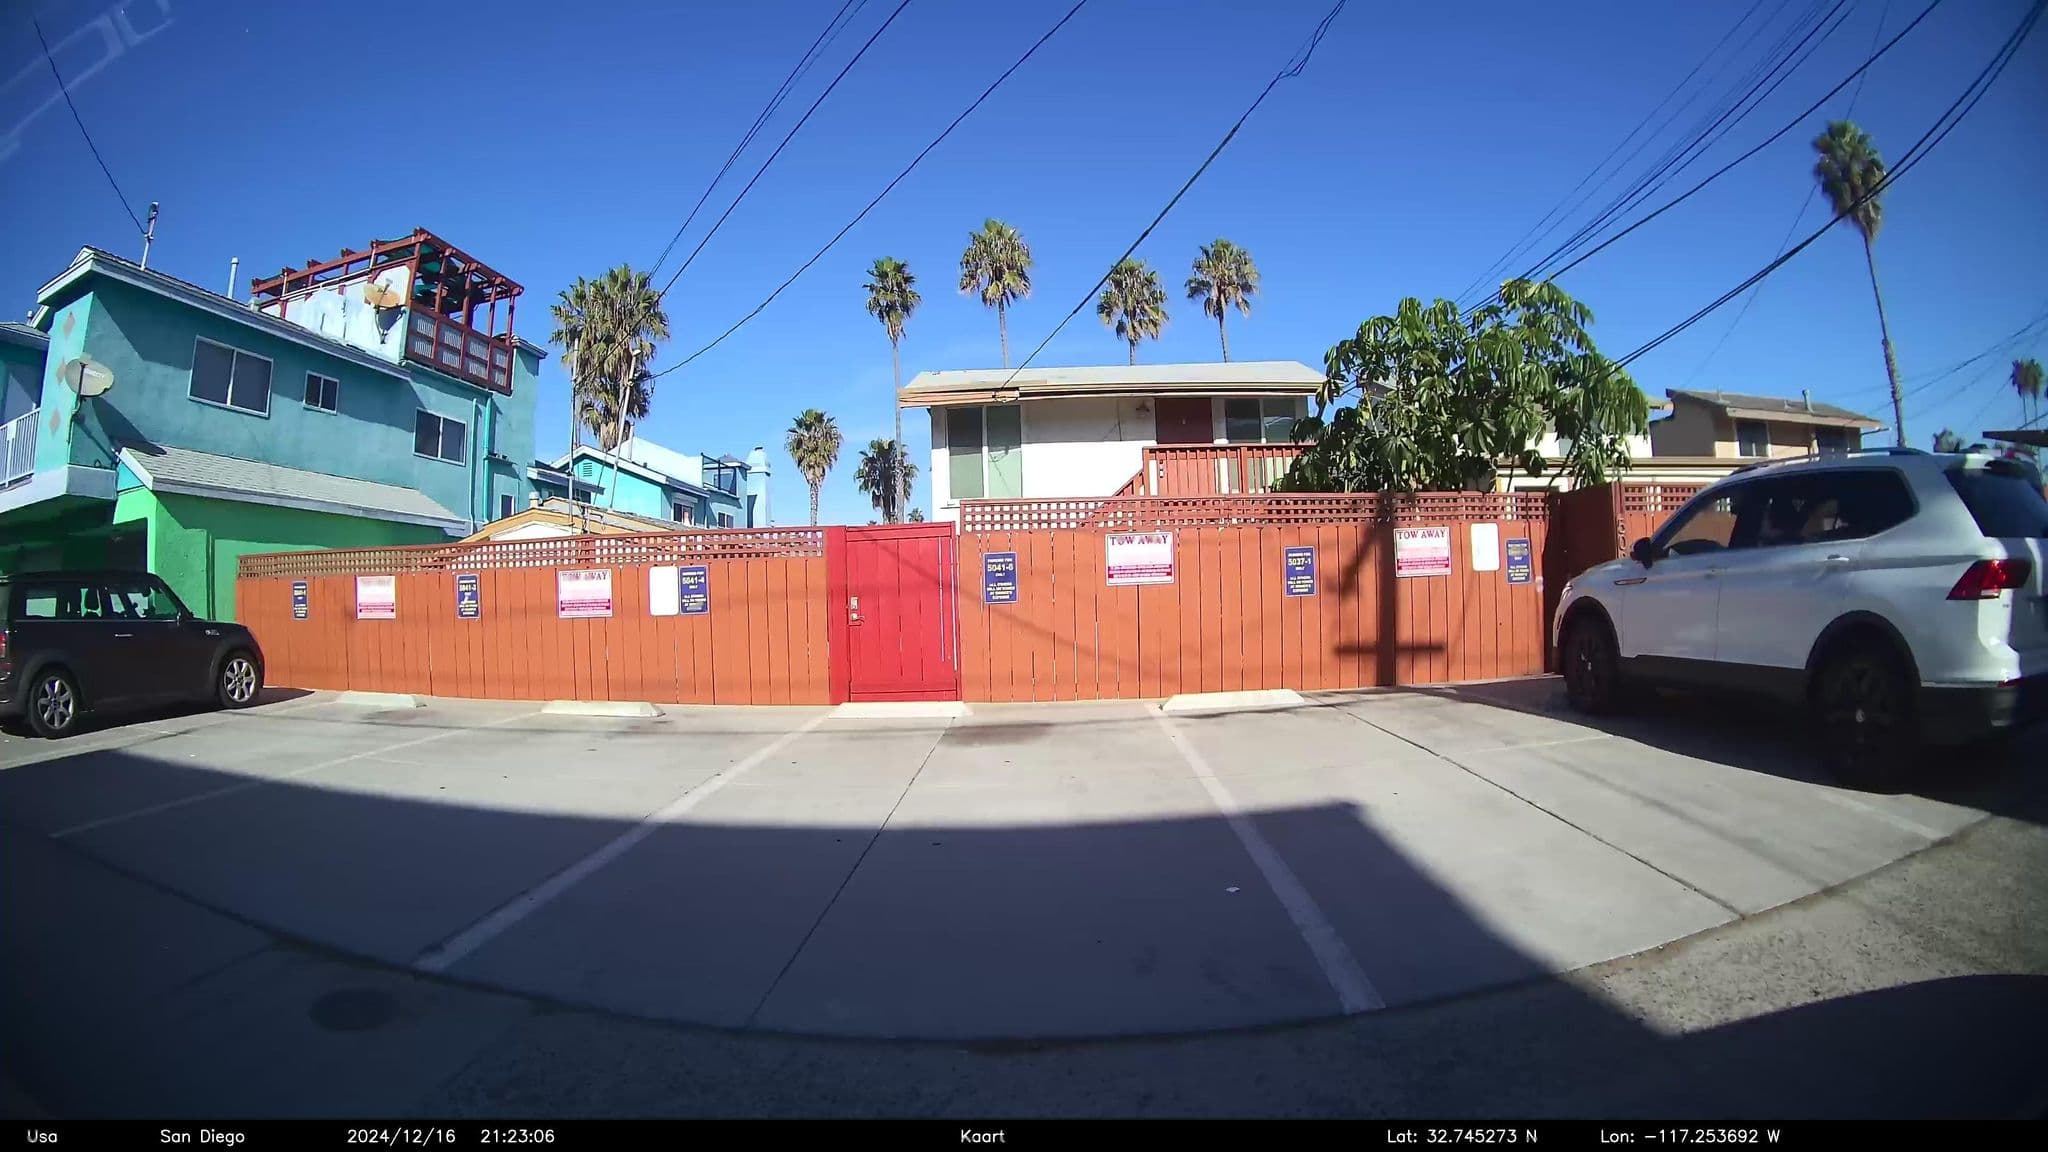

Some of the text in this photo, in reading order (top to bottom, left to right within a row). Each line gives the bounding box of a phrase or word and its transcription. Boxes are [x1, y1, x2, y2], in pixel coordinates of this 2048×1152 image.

[1110, 534, 1168, 546] TOW AWAY
[1397, 529, 1446, 540] TOW AWAY
[1287, 557, 1312, 566] 5037-1
